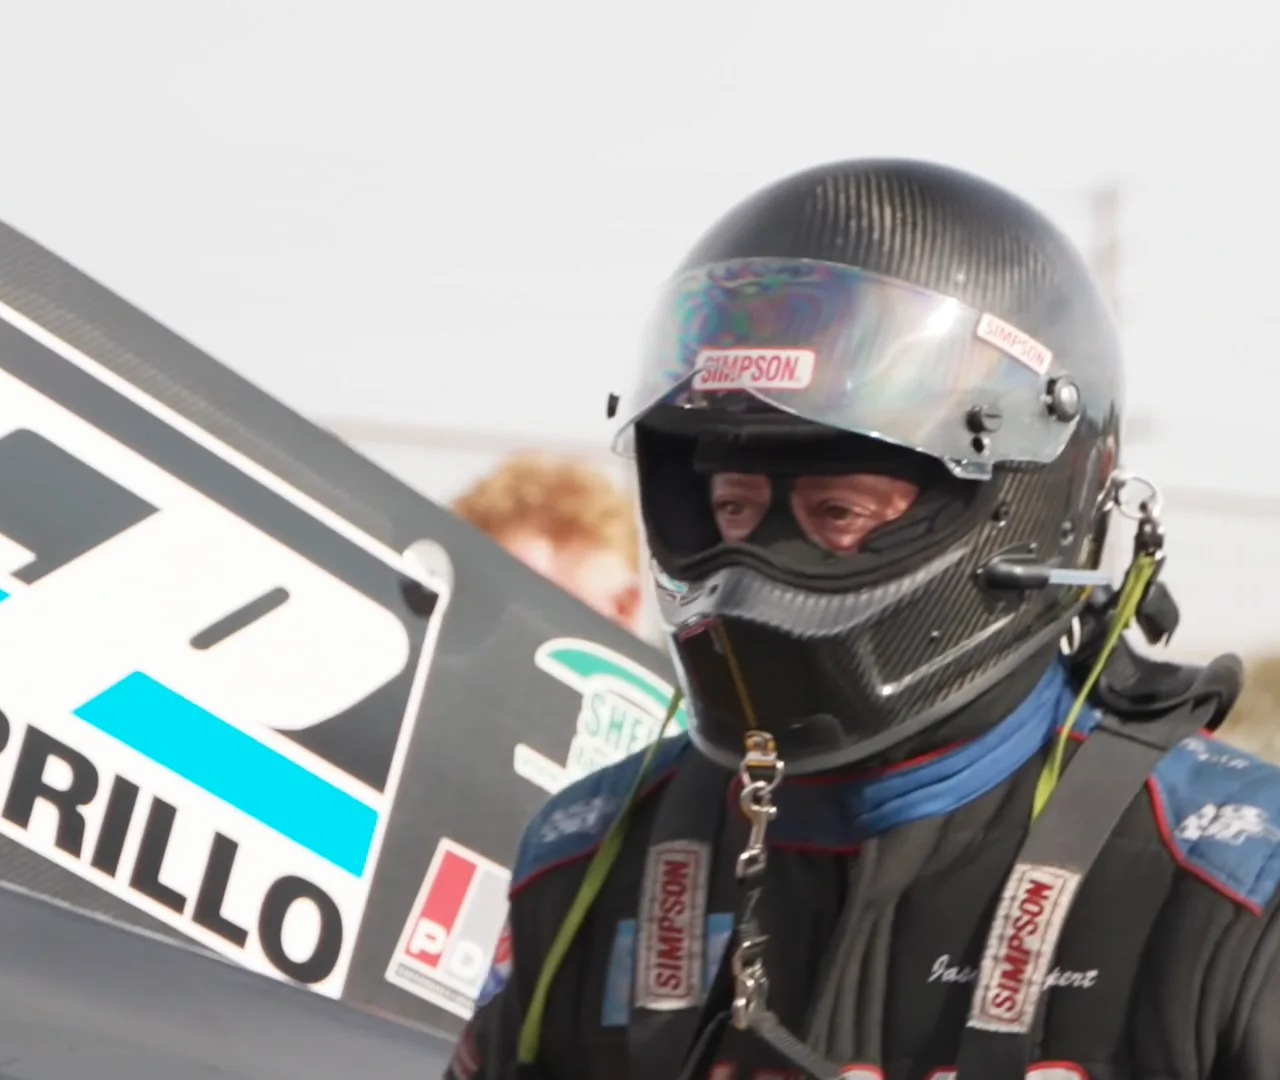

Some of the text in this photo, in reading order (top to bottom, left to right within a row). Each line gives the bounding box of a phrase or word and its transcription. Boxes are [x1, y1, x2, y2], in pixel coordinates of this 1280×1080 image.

[701, 354, 800, 385] SIMPSON
[984, 319, 1045, 367] SIMPSON
[654, 859, 690, 991] SIMPSON
[991, 878, 1054, 1013] SIMPSON
